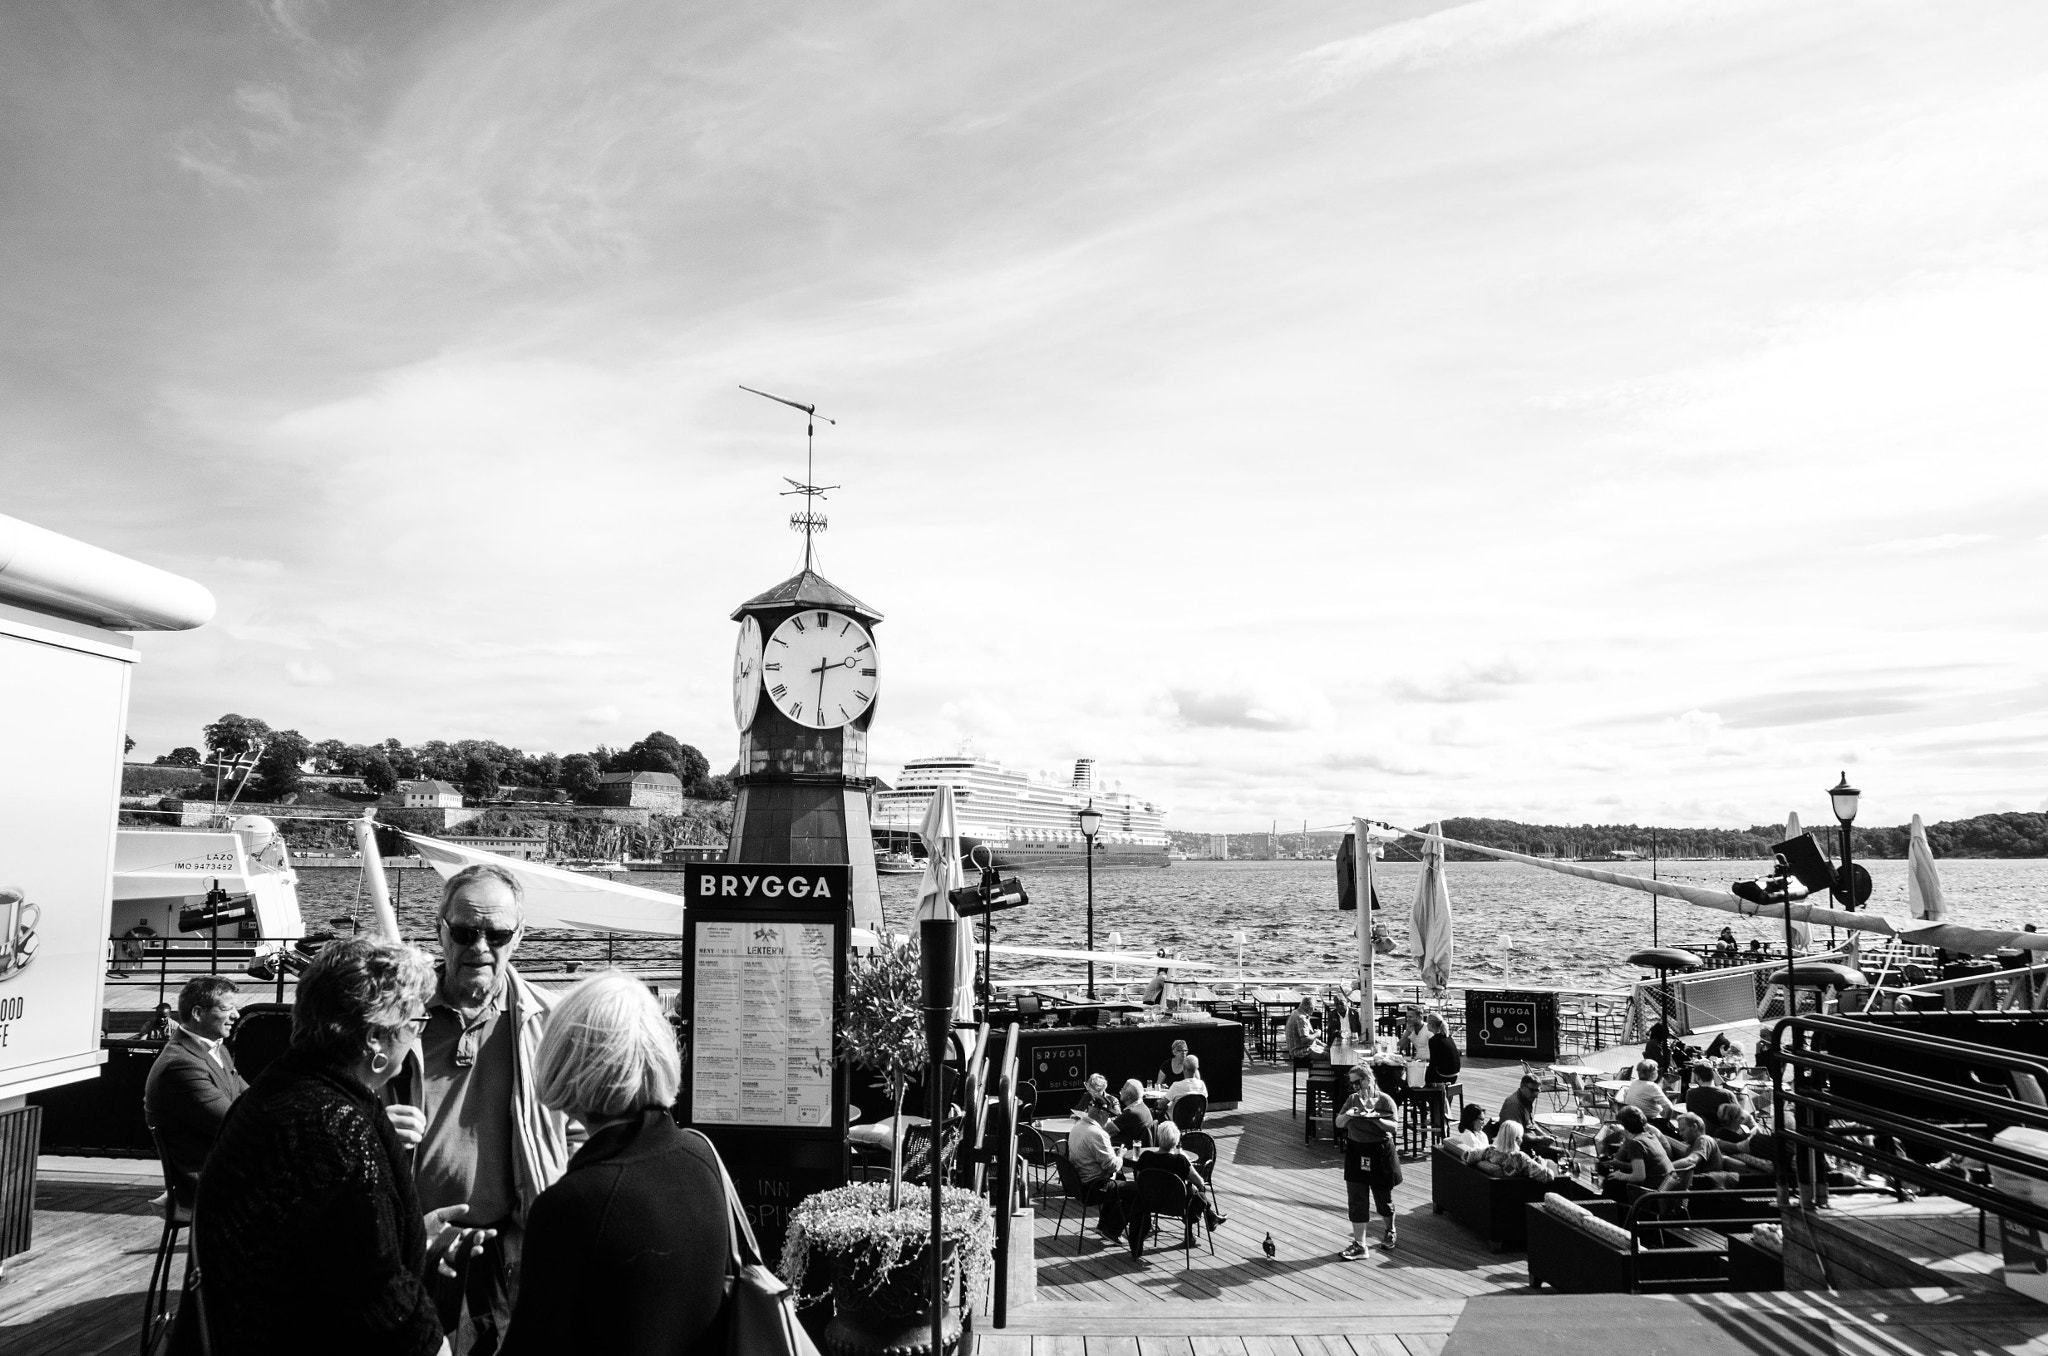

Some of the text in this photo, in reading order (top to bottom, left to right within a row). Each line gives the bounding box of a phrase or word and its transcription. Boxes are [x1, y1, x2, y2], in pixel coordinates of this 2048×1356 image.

[206, 853, 233, 861] LAZO
[174, 862, 192, 870] IMO
[700, 874, 832, 898] BRYGGA
[1489, 1006, 1530, 1015] BRYGGA
[1036, 1049, 1082, 1060] BRYGGA
[758, 1178, 790, 1198] INN
